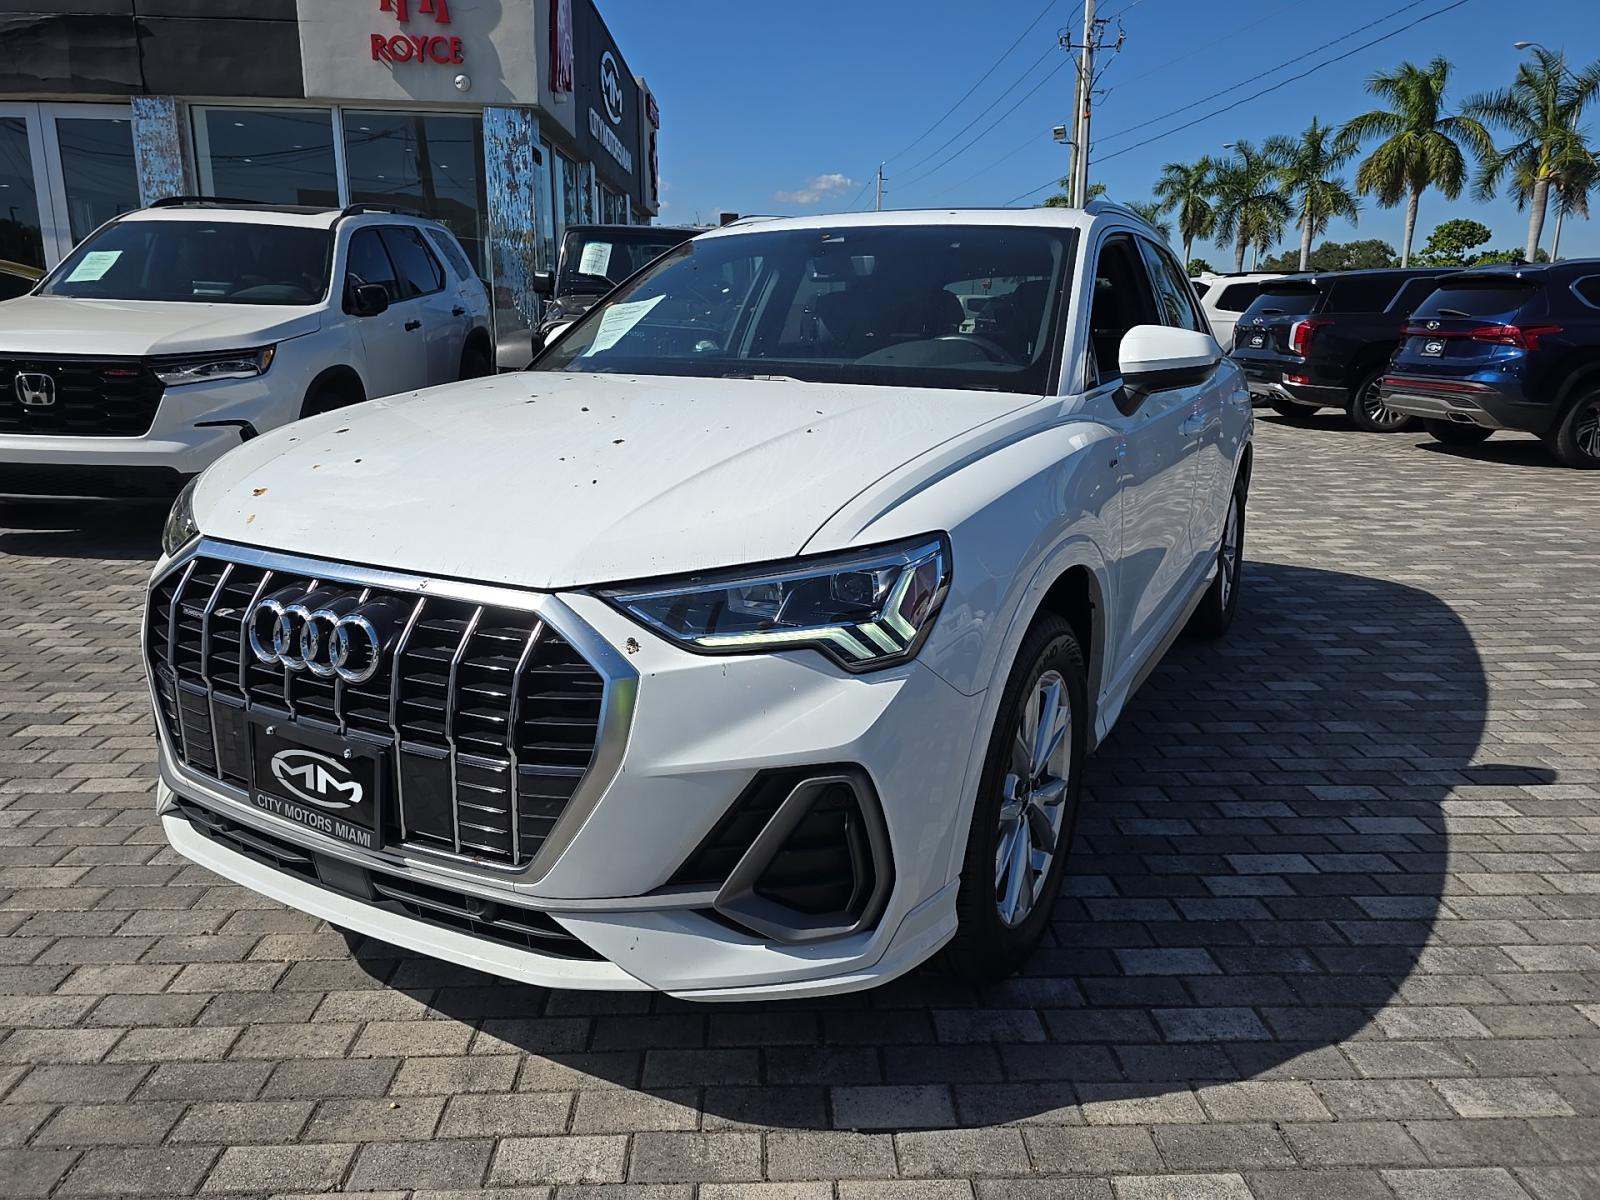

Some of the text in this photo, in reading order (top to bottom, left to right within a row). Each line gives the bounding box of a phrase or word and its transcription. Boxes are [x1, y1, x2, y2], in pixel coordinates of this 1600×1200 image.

[370, 33, 464, 64] ROYCE
[257, 794, 371, 847] CITY MOTORS MIAMI
